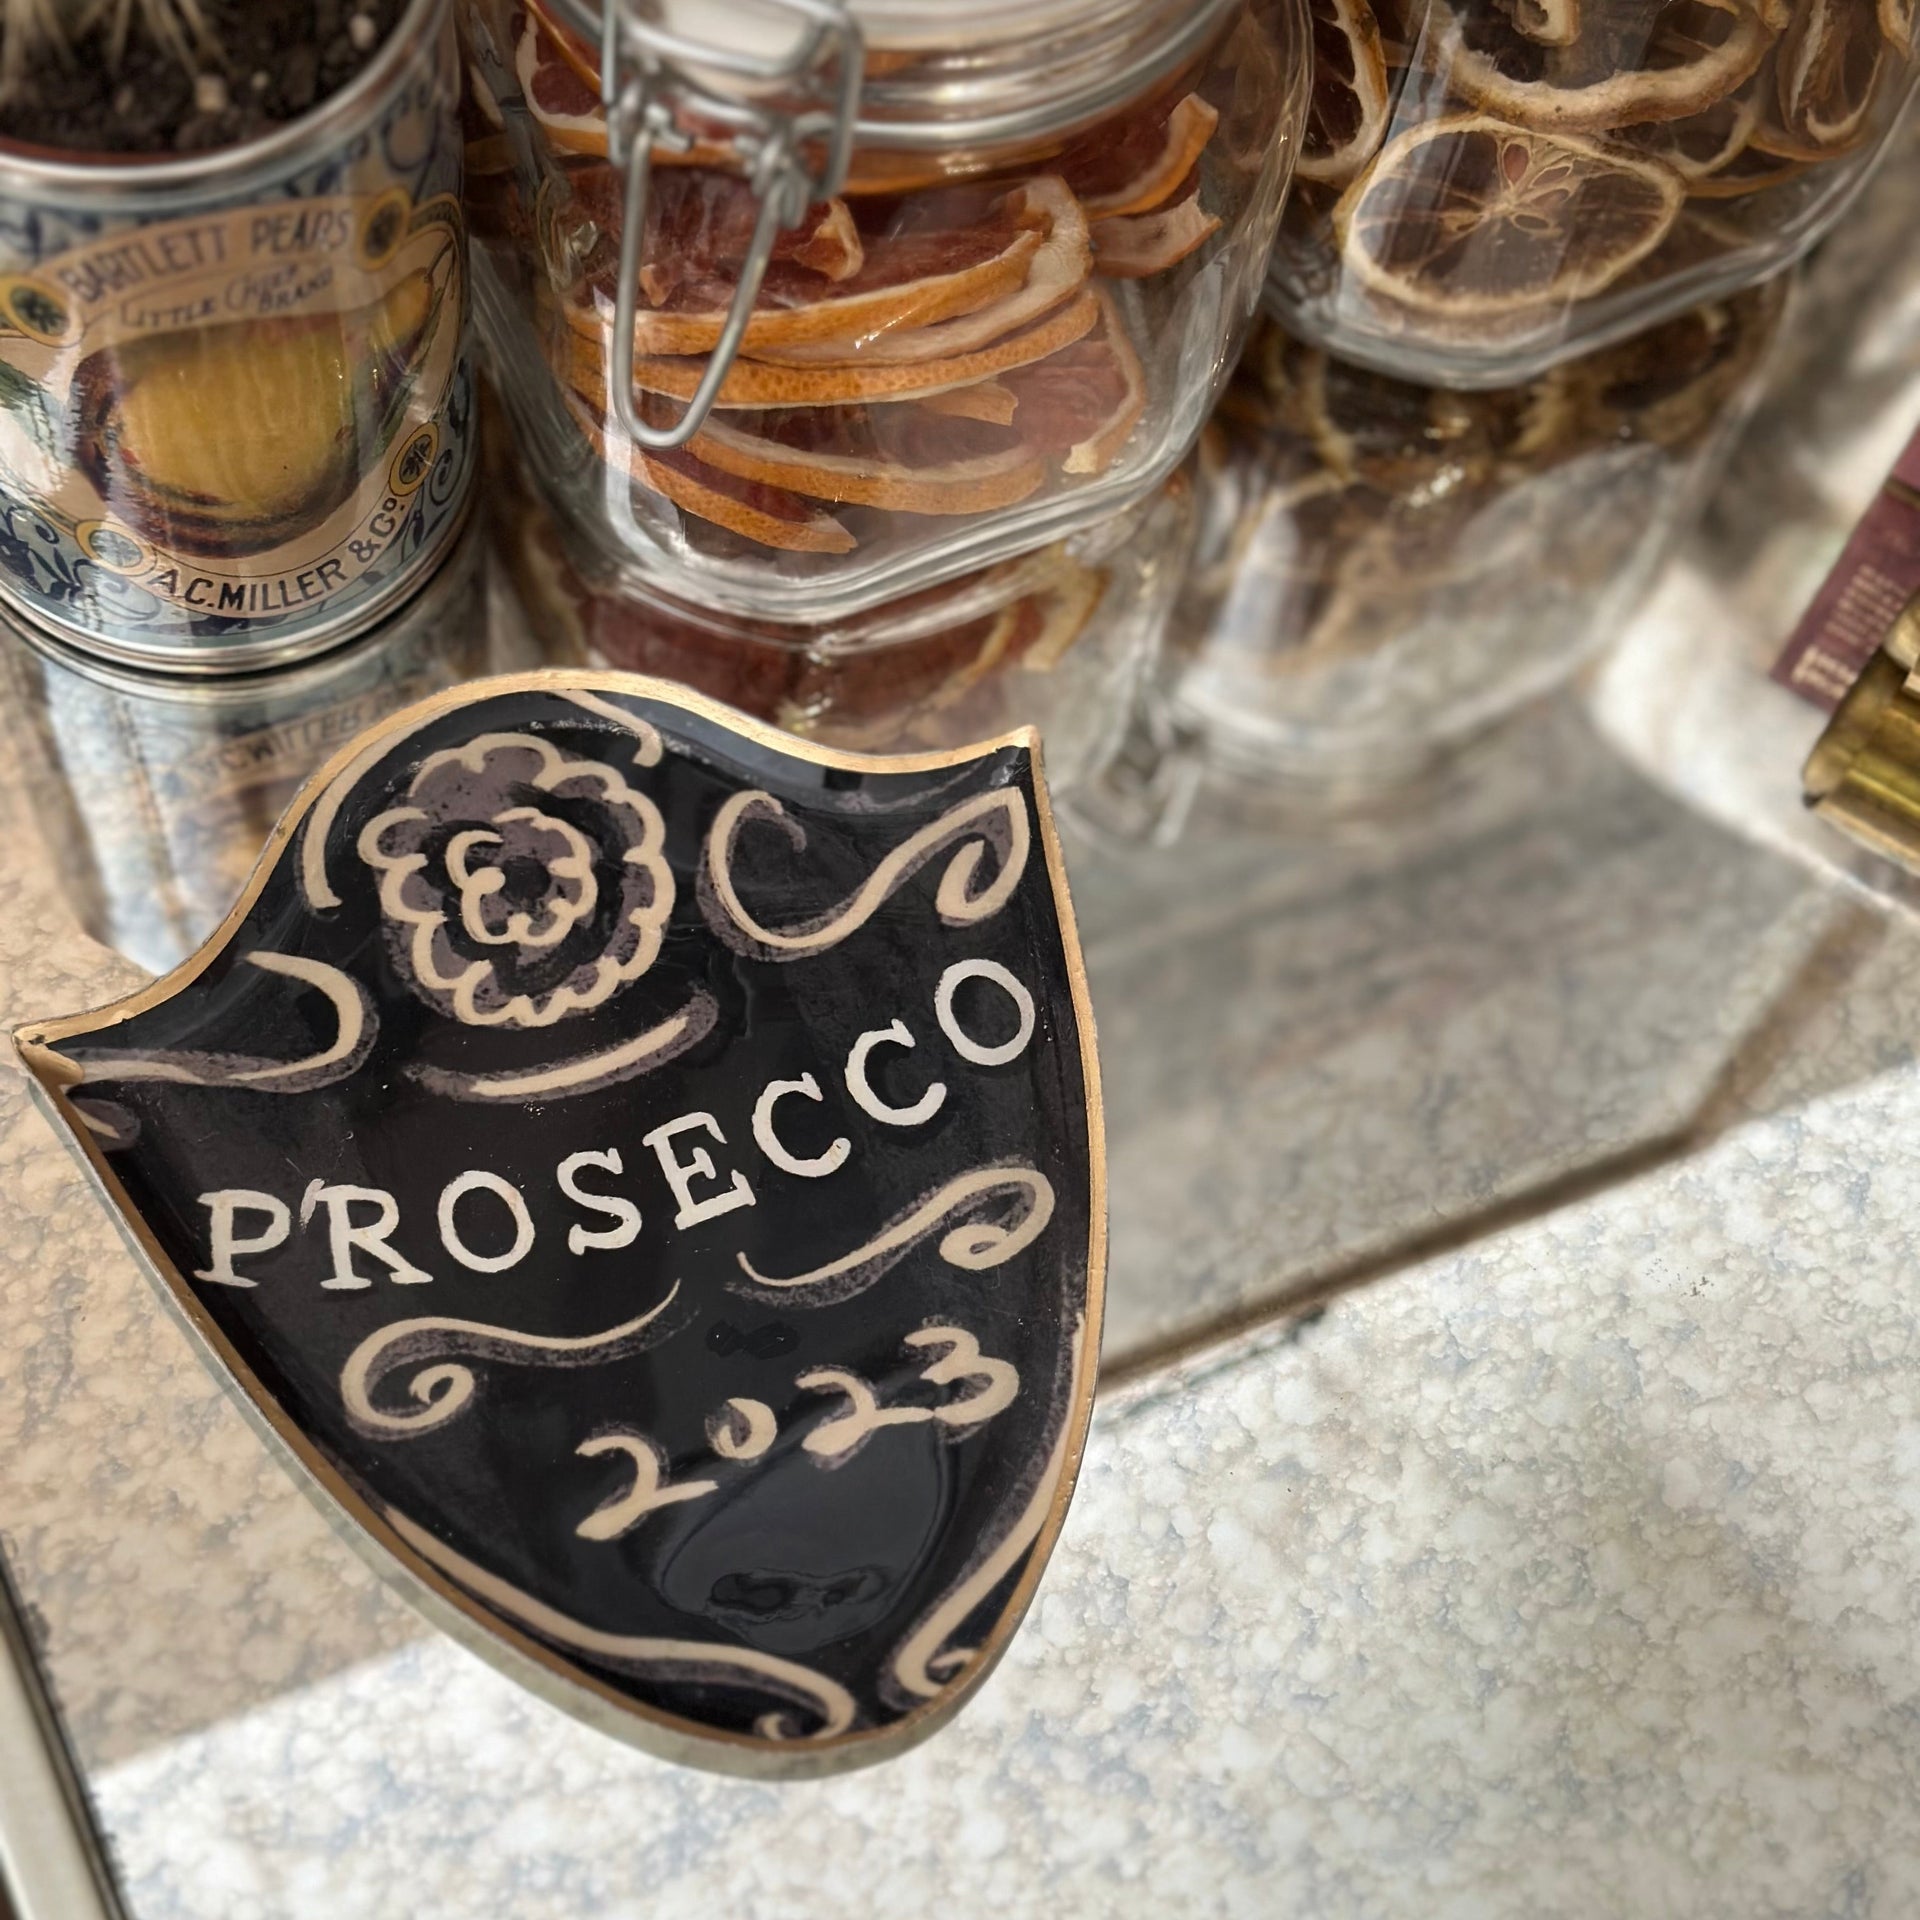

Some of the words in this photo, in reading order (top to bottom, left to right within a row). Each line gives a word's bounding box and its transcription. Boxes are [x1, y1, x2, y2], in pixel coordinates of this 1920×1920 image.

[59, 224, 226, 303] BARTLETT
[251, 208, 351, 255] PEARS
[193, 957, 1036, 1290] PROSECCO
[574, 1323, 1021, 1543] 2023
